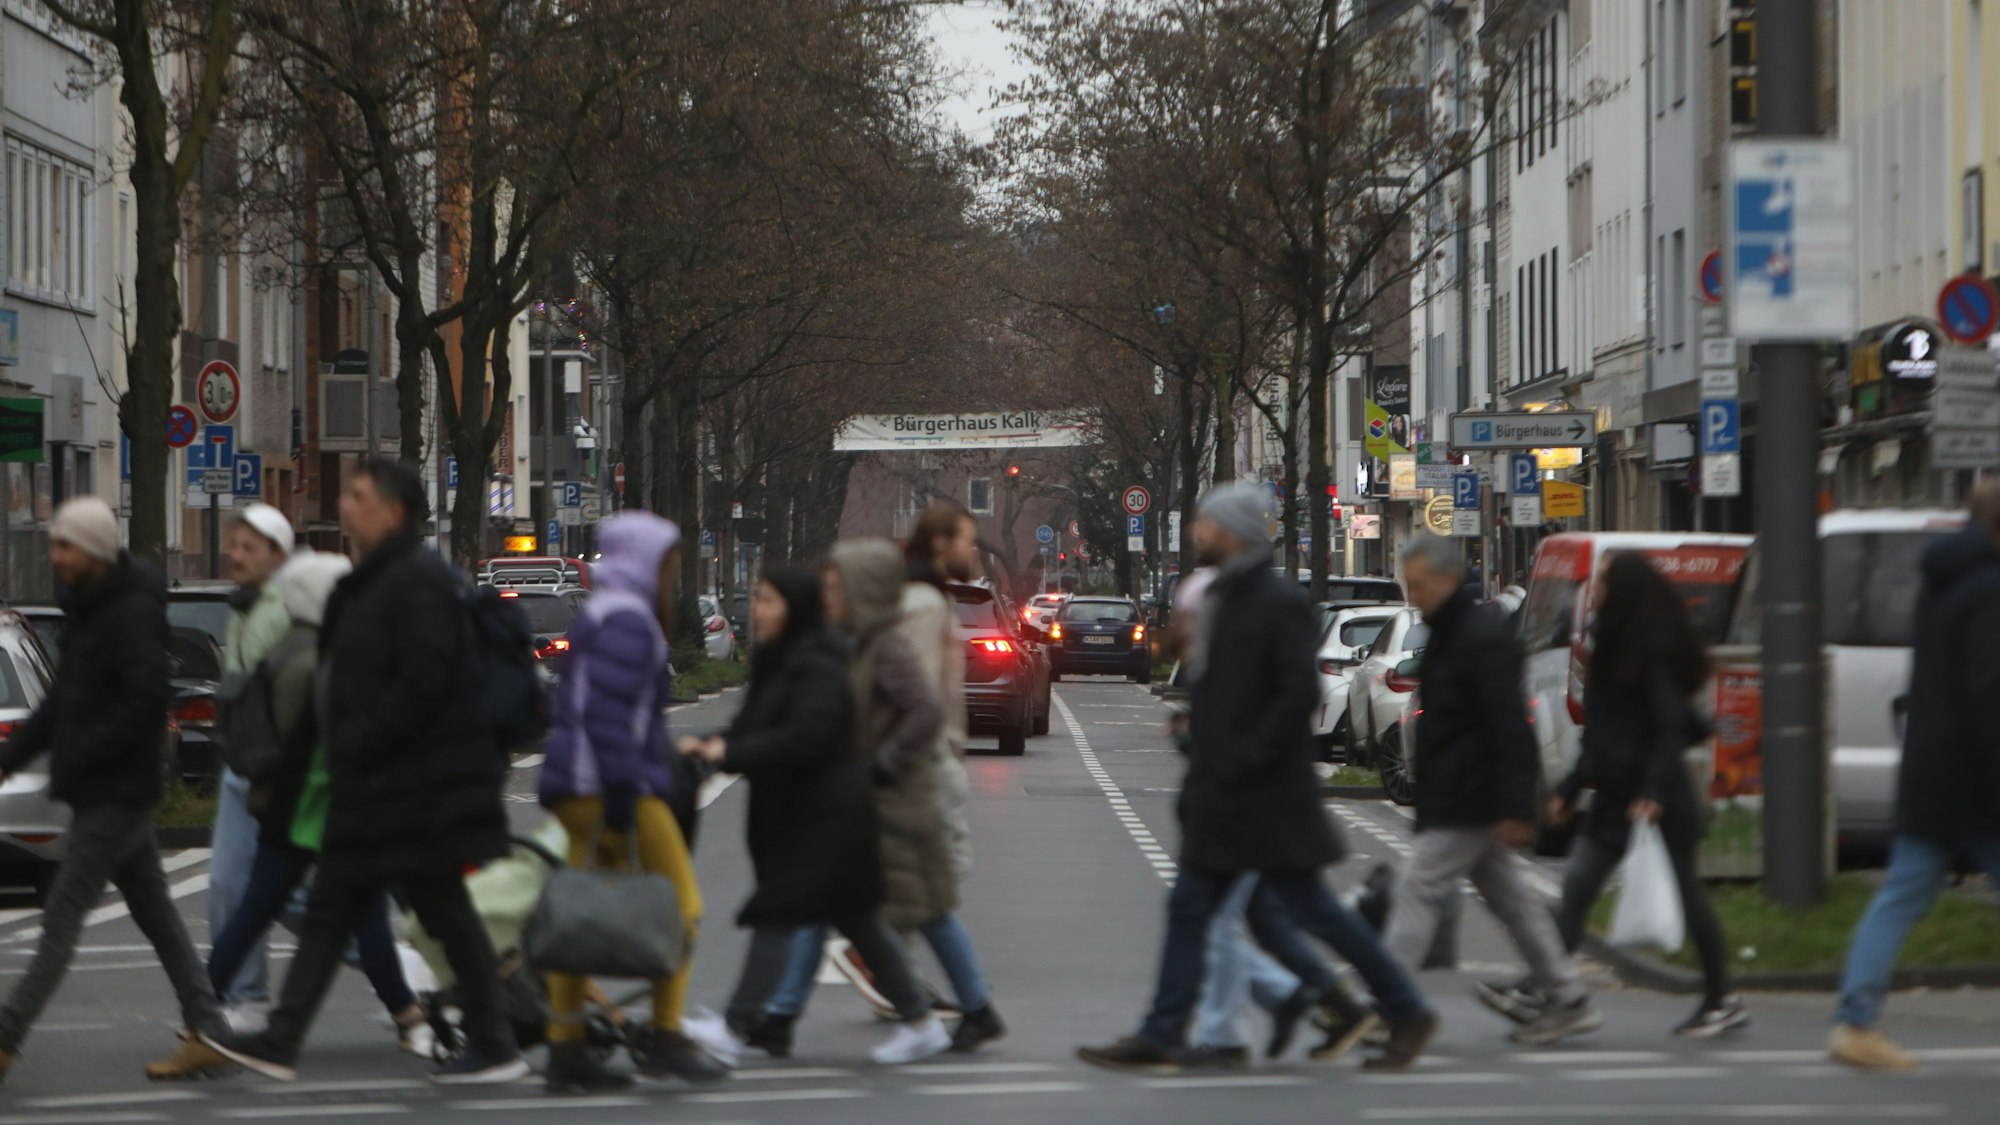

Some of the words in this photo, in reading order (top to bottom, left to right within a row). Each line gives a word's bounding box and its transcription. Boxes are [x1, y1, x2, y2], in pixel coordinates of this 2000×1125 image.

[894, 415, 997, 435] Bürgerhaus
[1002, 411, 1041, 429] Kalk
[1476, 424, 1488, 439] P
[1496, 424, 1563, 440] Bürgerhaus
[1708, 405, 1728, 446] P
[236, 459, 253, 491] P
[1515, 459, 1531, 490] P
[565, 485, 577, 504] P
[1129, 494, 1144, 507] 30
[1457, 477, 1472, 504] P
[548, 522, 557, 539] P
[1130, 517, 1139, 533] P
